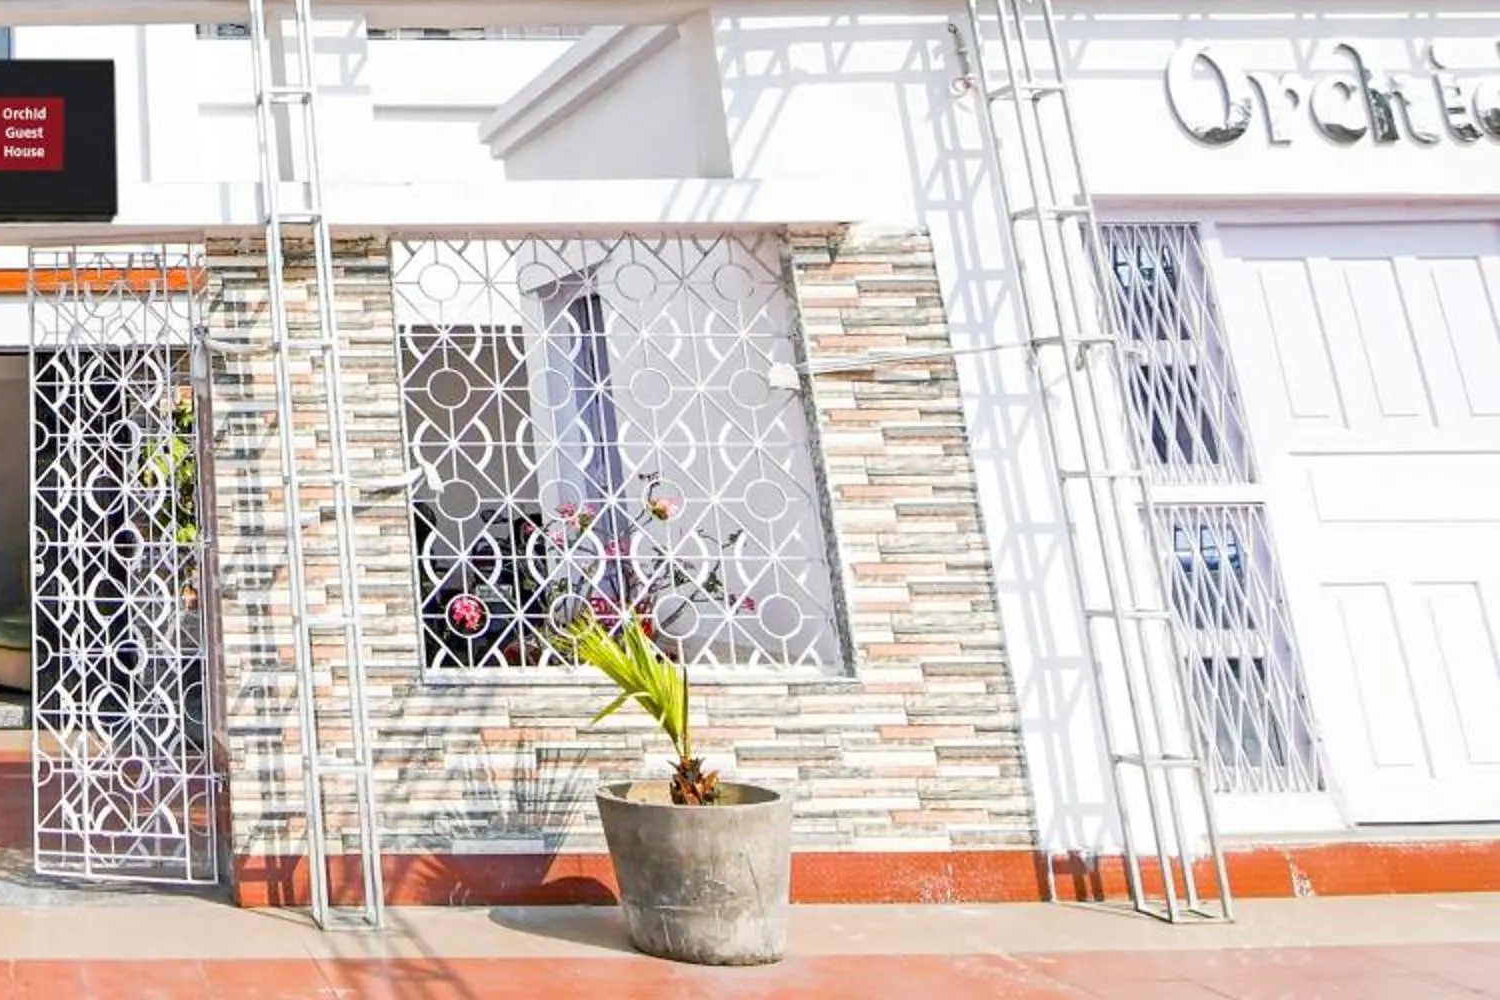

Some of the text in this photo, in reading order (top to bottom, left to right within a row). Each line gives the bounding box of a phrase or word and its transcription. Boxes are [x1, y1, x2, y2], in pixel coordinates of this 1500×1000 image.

[3, 107, 47, 120] Orchid
[5, 126, 44, 139] Guest
[3, 145, 45, 158] House
